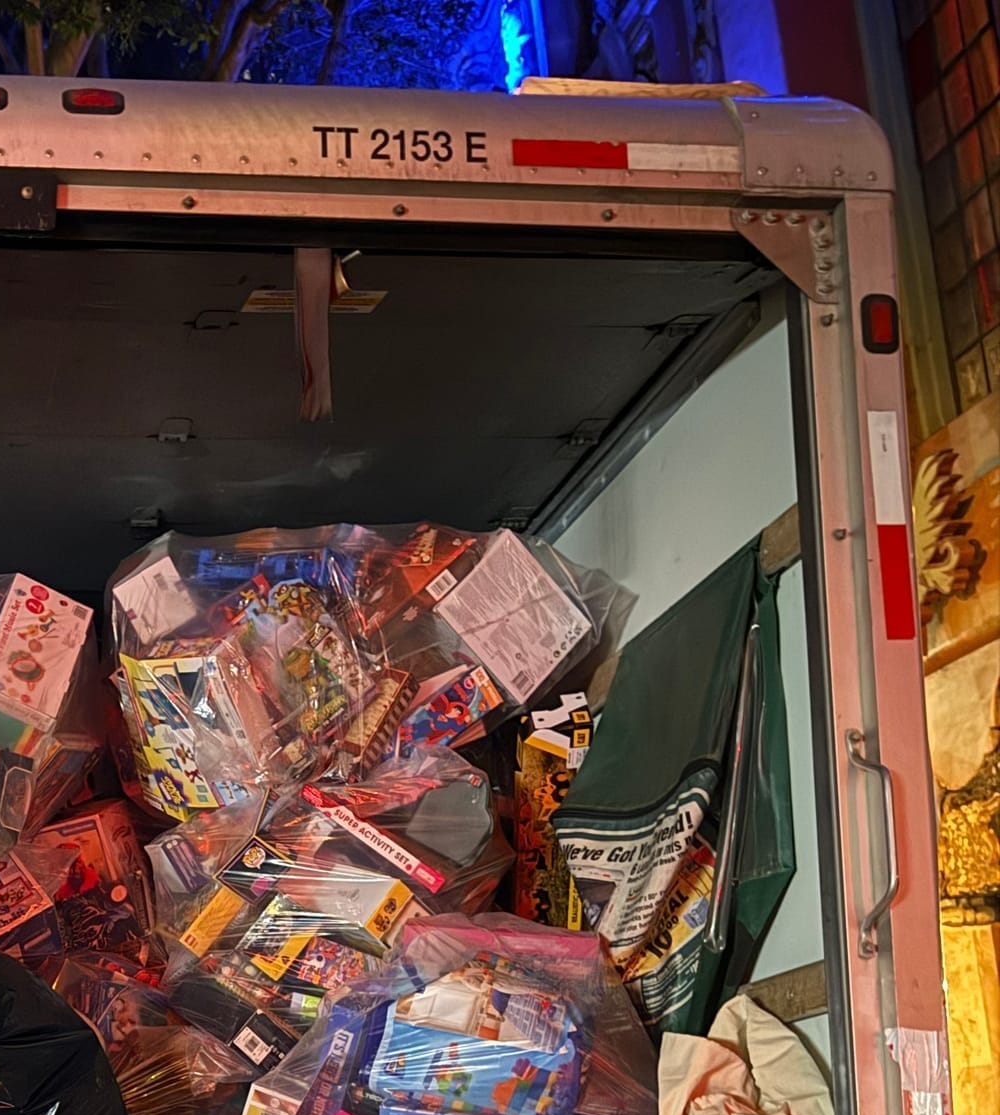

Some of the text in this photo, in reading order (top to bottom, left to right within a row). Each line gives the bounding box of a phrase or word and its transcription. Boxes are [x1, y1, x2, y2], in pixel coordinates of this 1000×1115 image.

[313, 127, 487, 164] TT 2153 E
[333, 808, 409, 866] SUPER ACTIVITY SET
